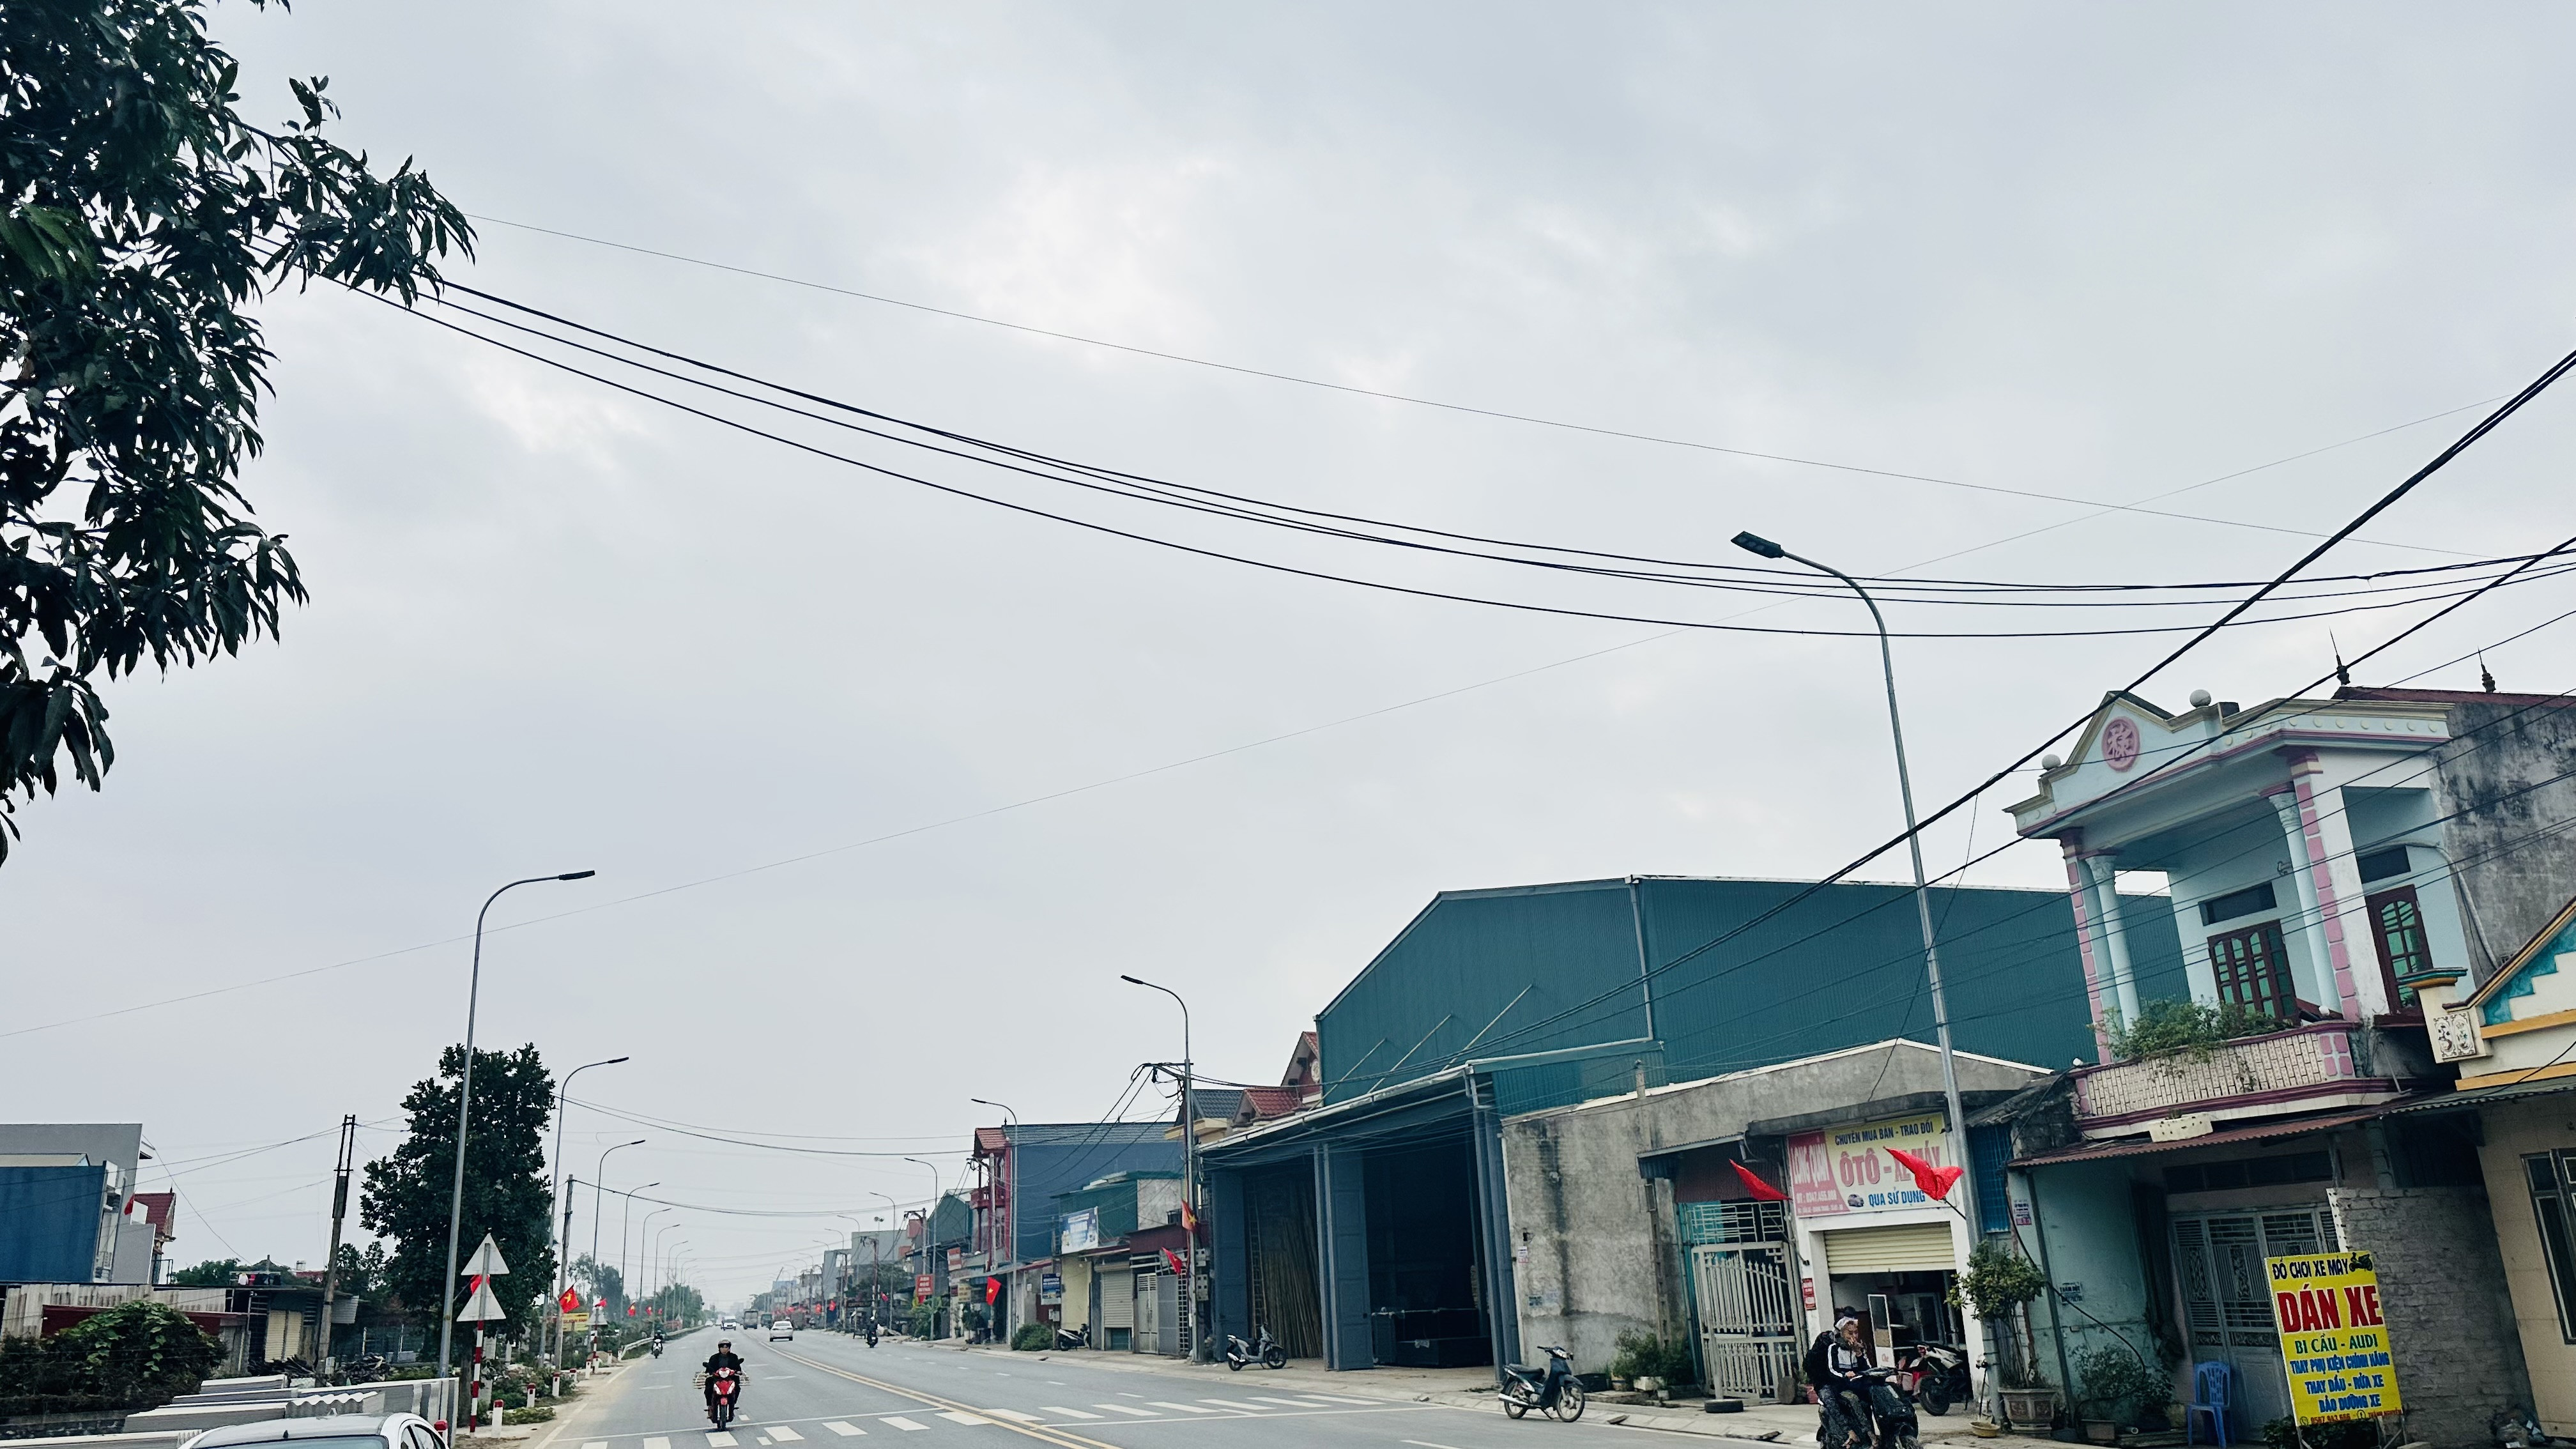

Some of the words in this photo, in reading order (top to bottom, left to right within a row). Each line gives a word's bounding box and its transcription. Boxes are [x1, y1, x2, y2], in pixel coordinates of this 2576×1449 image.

[1862, 1129, 1878, 1142] MUA
[1900, 1123, 1919, 1137] TRAO
[1839, 1147, 1880, 1186] ÔTÔ
[1868, 1193, 1885, 1208] QUA
[1901, 1190, 1926, 1206] DỤNG
[2313, 1260, 2326, 1276] XE
[2327, 1255, 2349, 1276] MÁY
[2276, 1284, 2341, 1333] DÁN
[2343, 1285, 2384, 1328] XE
[2295, 1339, 2308, 1354] BI
[2349, 1333, 2378, 1349] AUDI
[2304, 1380, 2326, 1394] THAY
[2372, 1374, 2384, 1388] XE
[2369, 1393, 2381, 1407] XE
